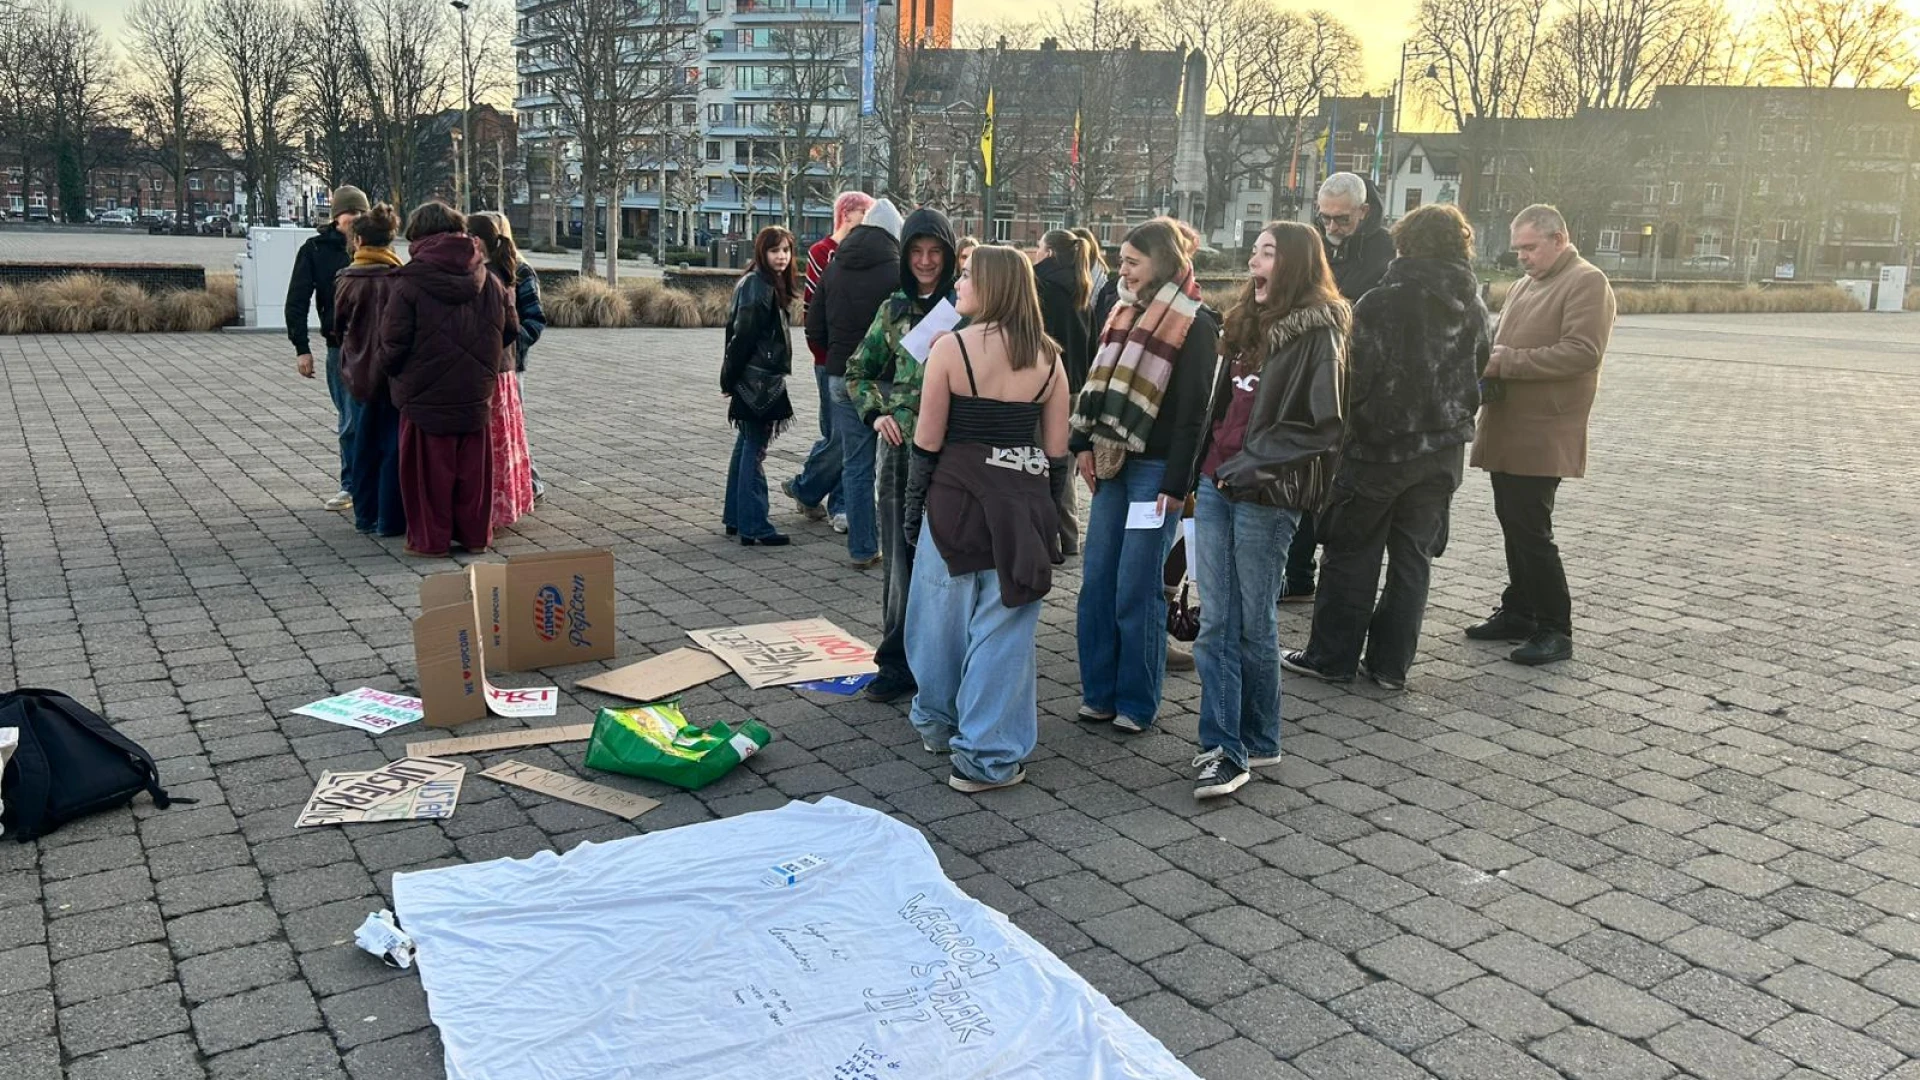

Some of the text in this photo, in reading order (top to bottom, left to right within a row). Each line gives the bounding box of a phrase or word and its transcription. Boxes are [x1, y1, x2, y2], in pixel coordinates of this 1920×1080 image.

[492, 586, 500, 646] WE POPCORN
[569, 574, 592, 647] Popcorn
[459, 629, 475, 696] WE POPCORN
[898, 893, 1000, 978] WAAROM
[911, 960, 995, 1043] STAAK
